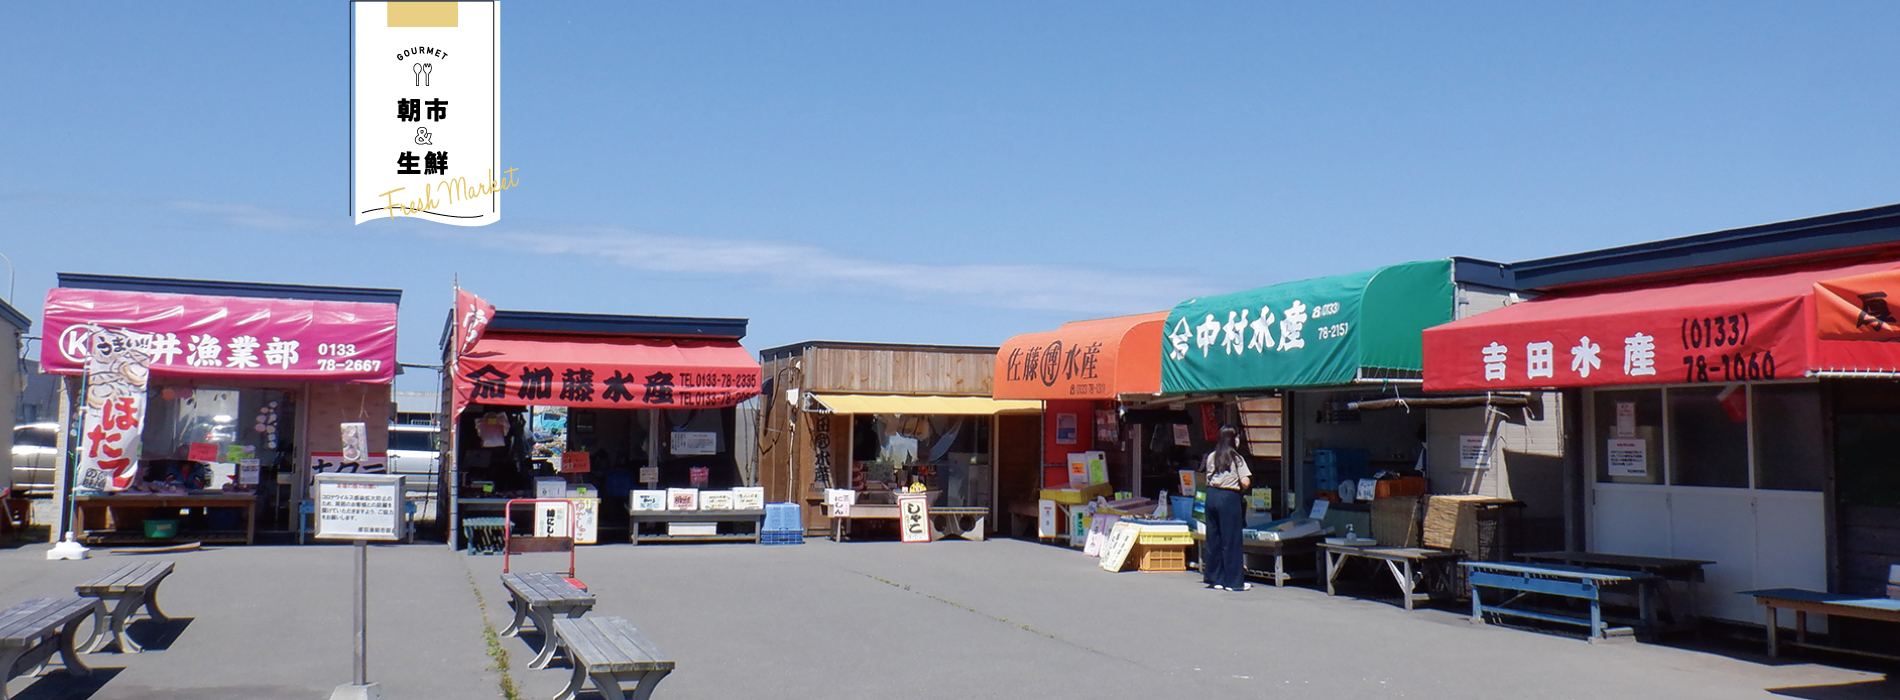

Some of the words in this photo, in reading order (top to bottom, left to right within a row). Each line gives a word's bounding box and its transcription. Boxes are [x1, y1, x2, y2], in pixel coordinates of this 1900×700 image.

[1195, 299, 1308, 358] 中村水産
[1317, 322, 1349, 341] 78-2151
[1682, 311, 1749, 350] (0133)
[318, 342, 356, 356] 0133
[1481, 331, 1656, 382] 吉田水産
[317, 358, 382, 373] 78-2667
[679, 373, 694, 387] TEL
[695, 373, 757, 388] 0133-78-2335
[1683, 350, 1775, 383] 78-1060
[517, 365, 675, 405] 加藤水産
[679, 392, 694, 405] TEL
[86, 396, 139, 489] ほたて
[907, 502, 922, 533] しゃこ
